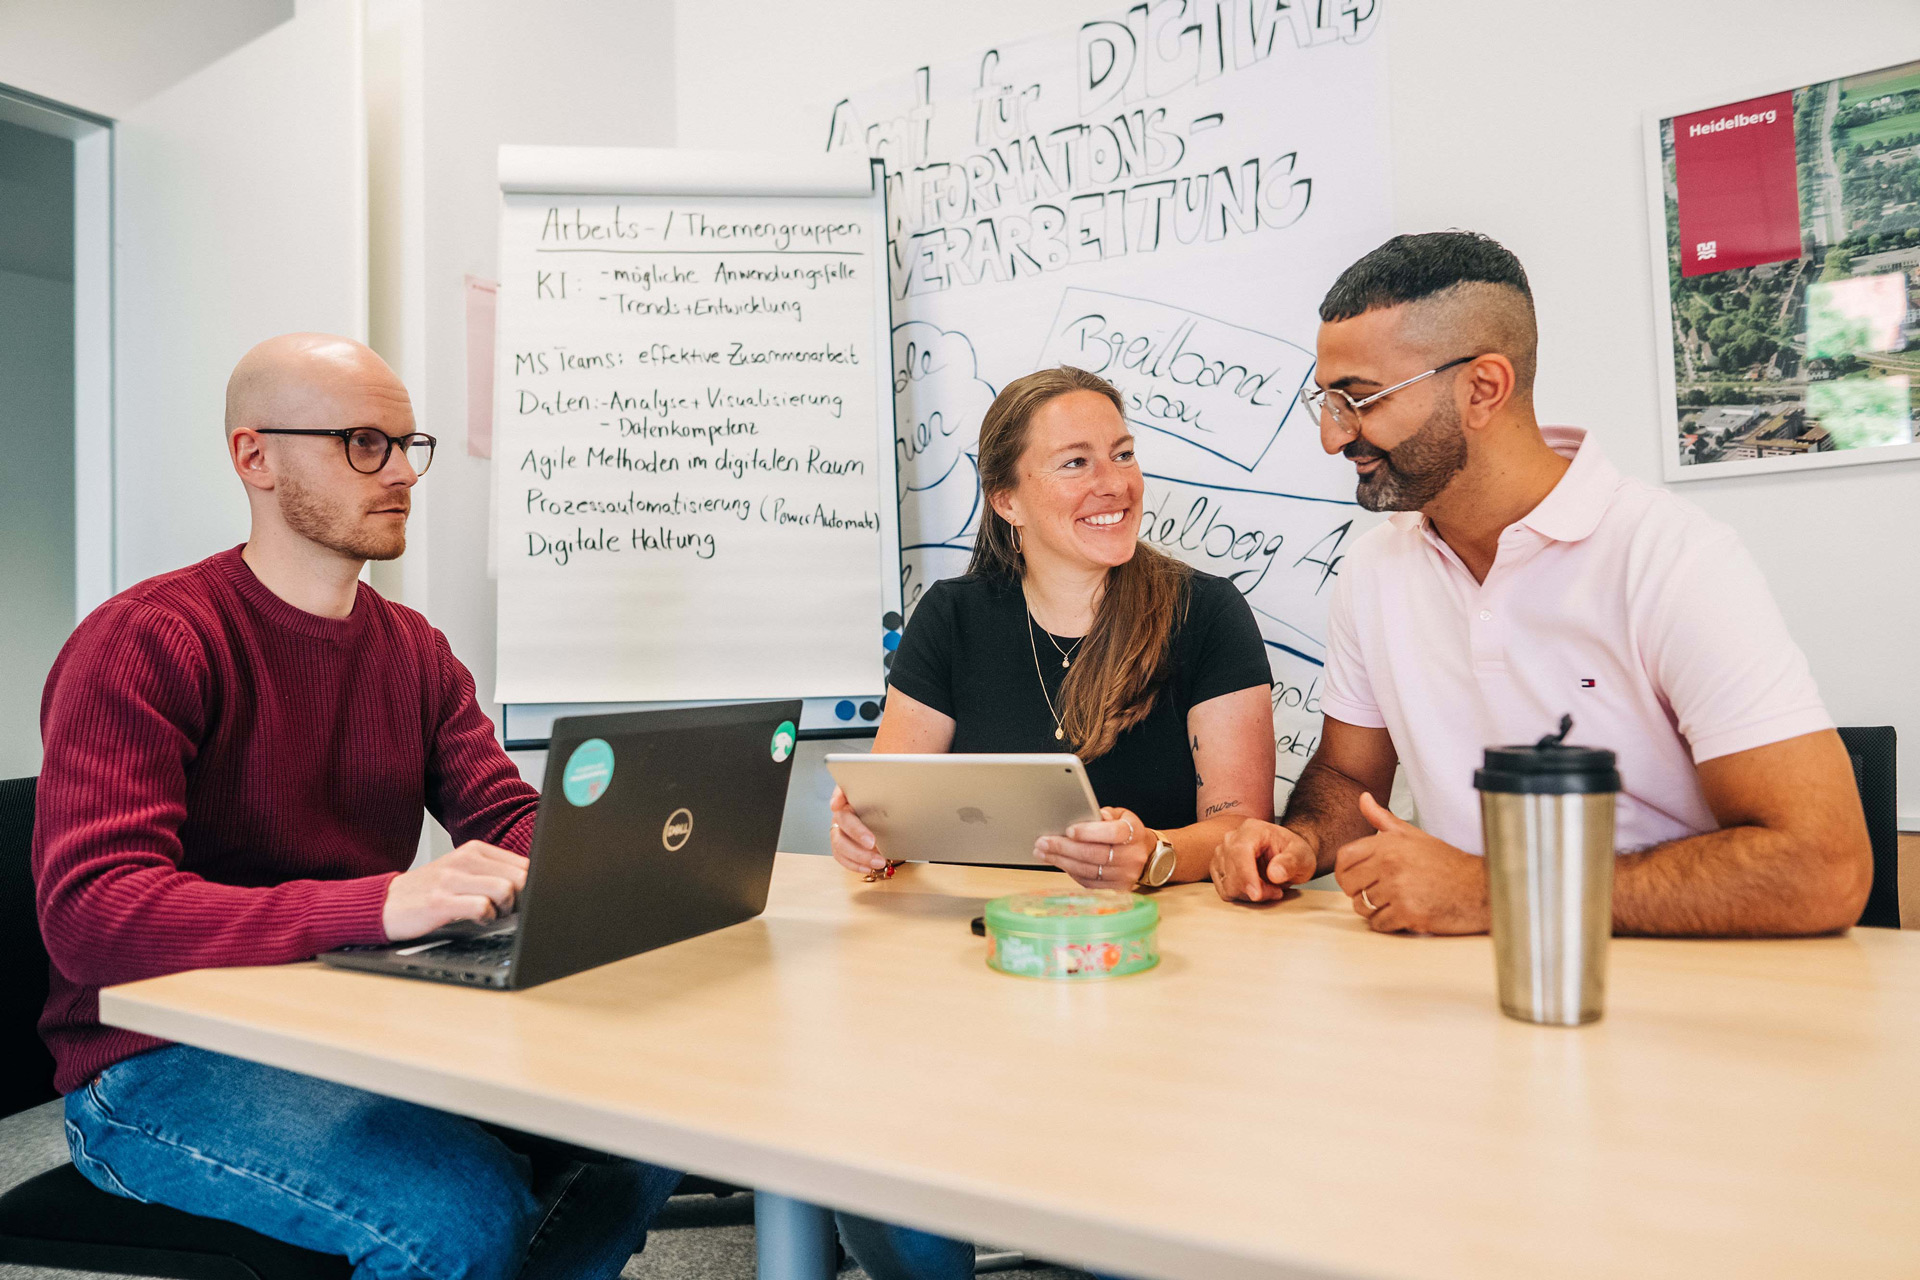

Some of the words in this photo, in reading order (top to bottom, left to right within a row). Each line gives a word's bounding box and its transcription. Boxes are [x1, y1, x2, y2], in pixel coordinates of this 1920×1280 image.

[972, 49, 1041, 147] für
[1689, 109, 1777, 138] Heidelberg
[681, 211, 862, 251] Themengruppen
[888, 152, 1312, 300] VERARBEITUNG
[714, 262, 856, 290] Anwendungsfälle
[515, 352, 549, 376] MS
[553, 346, 624, 371] Teams:
[638, 343, 720, 365] effektive
[726, 342, 860, 366] Zusammenarbeit
[706, 386, 844, 419] Visualisierung
[619, 416, 759, 446] Datenkompetenz
[520, 446, 577, 480] Agile
[586, 446, 680, 474] Methoden
[687, 453, 708, 470] im
[714, 448, 799, 480] digitalen
[806, 445, 866, 476] Raum
[527, 488, 752, 521] Prozessautomatisierung
[527, 527, 621, 566] Digitale
[632, 527, 717, 560] Haltung
[667, 822, 690, 838] DELL
